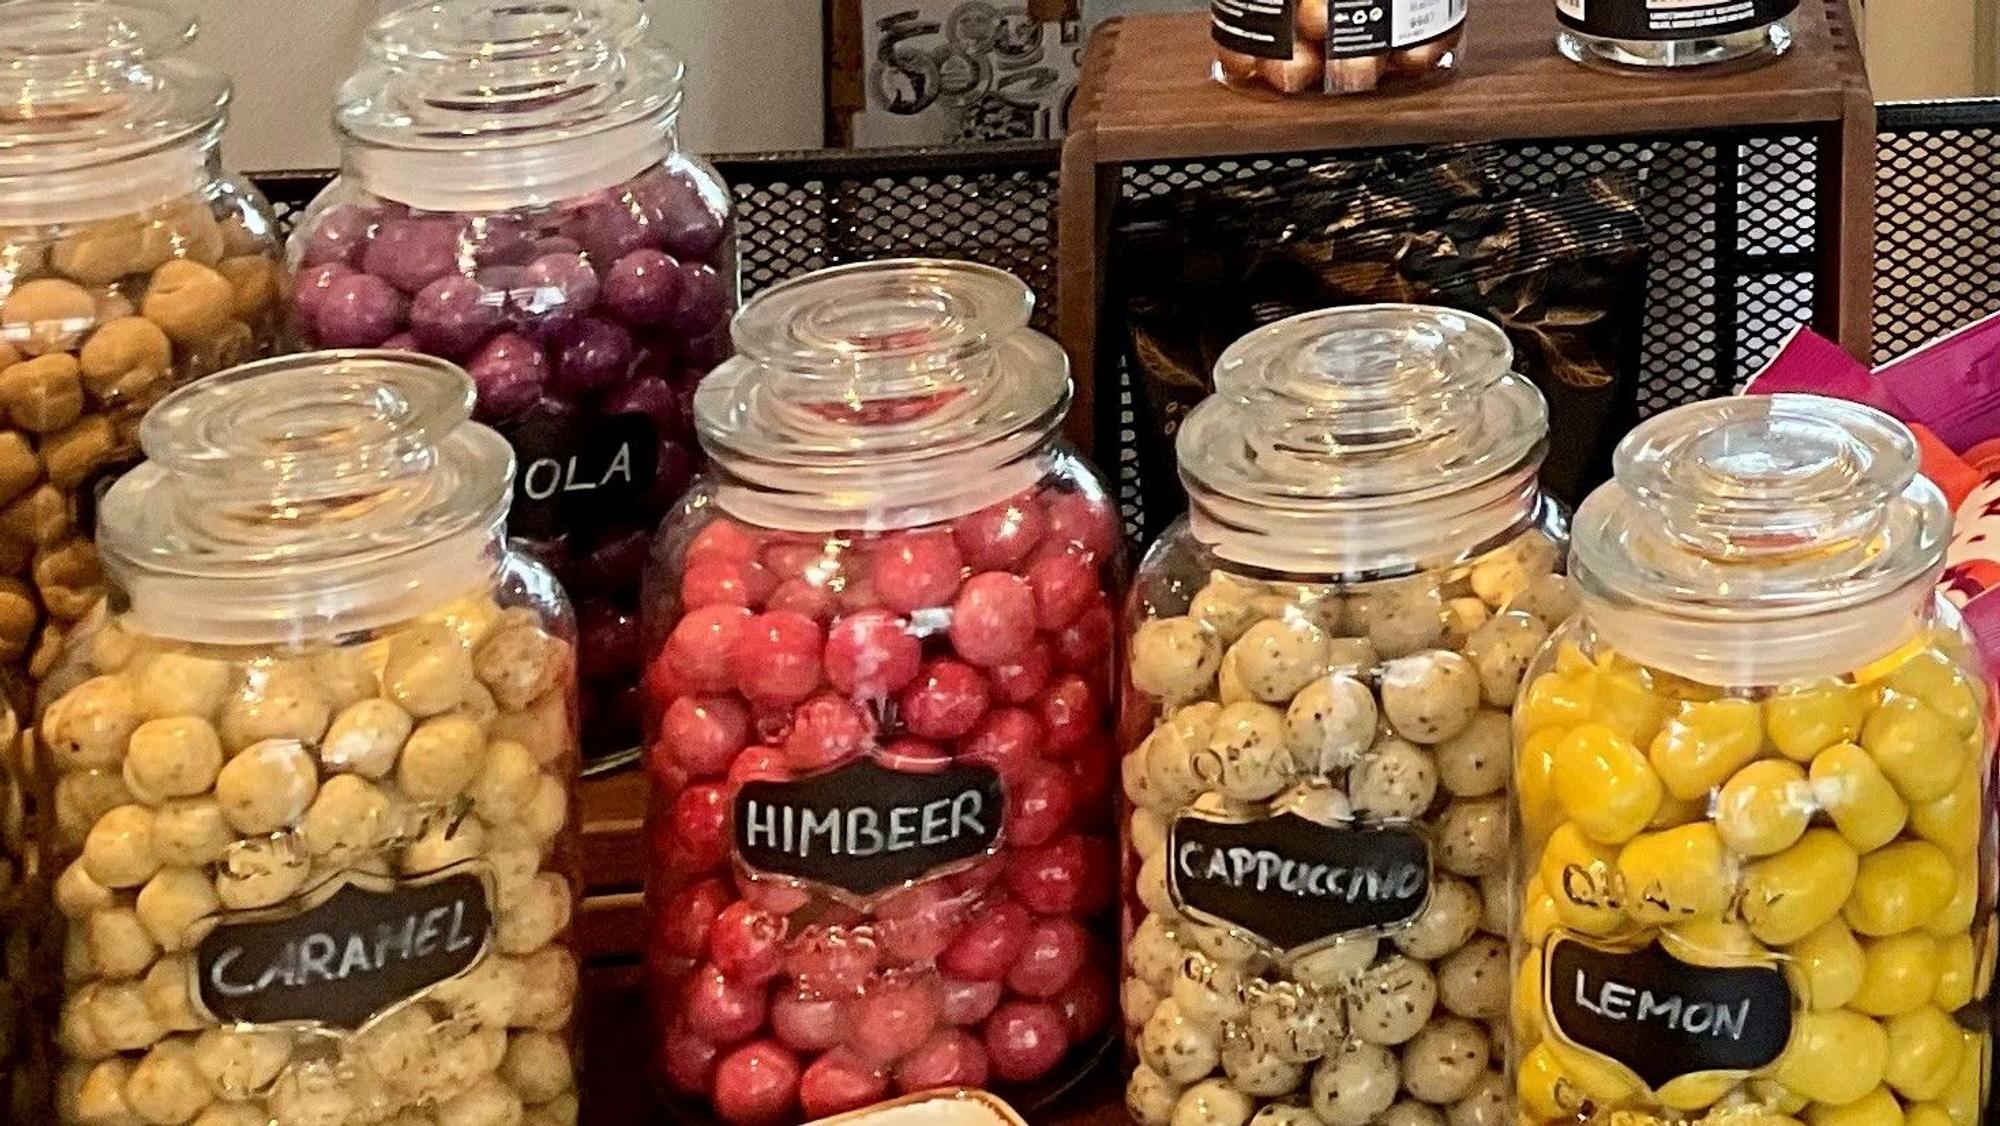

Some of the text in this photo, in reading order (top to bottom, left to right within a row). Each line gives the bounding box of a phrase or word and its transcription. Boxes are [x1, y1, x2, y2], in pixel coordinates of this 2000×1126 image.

[525, 441, 632, 499] OLA
[747, 790, 985, 857] HIMBEER
[1179, 840, 1427, 904] CAPPUCCINO
[210, 900, 475, 997] CARAMEL
[1575, 968, 1750, 1041] LEMON
